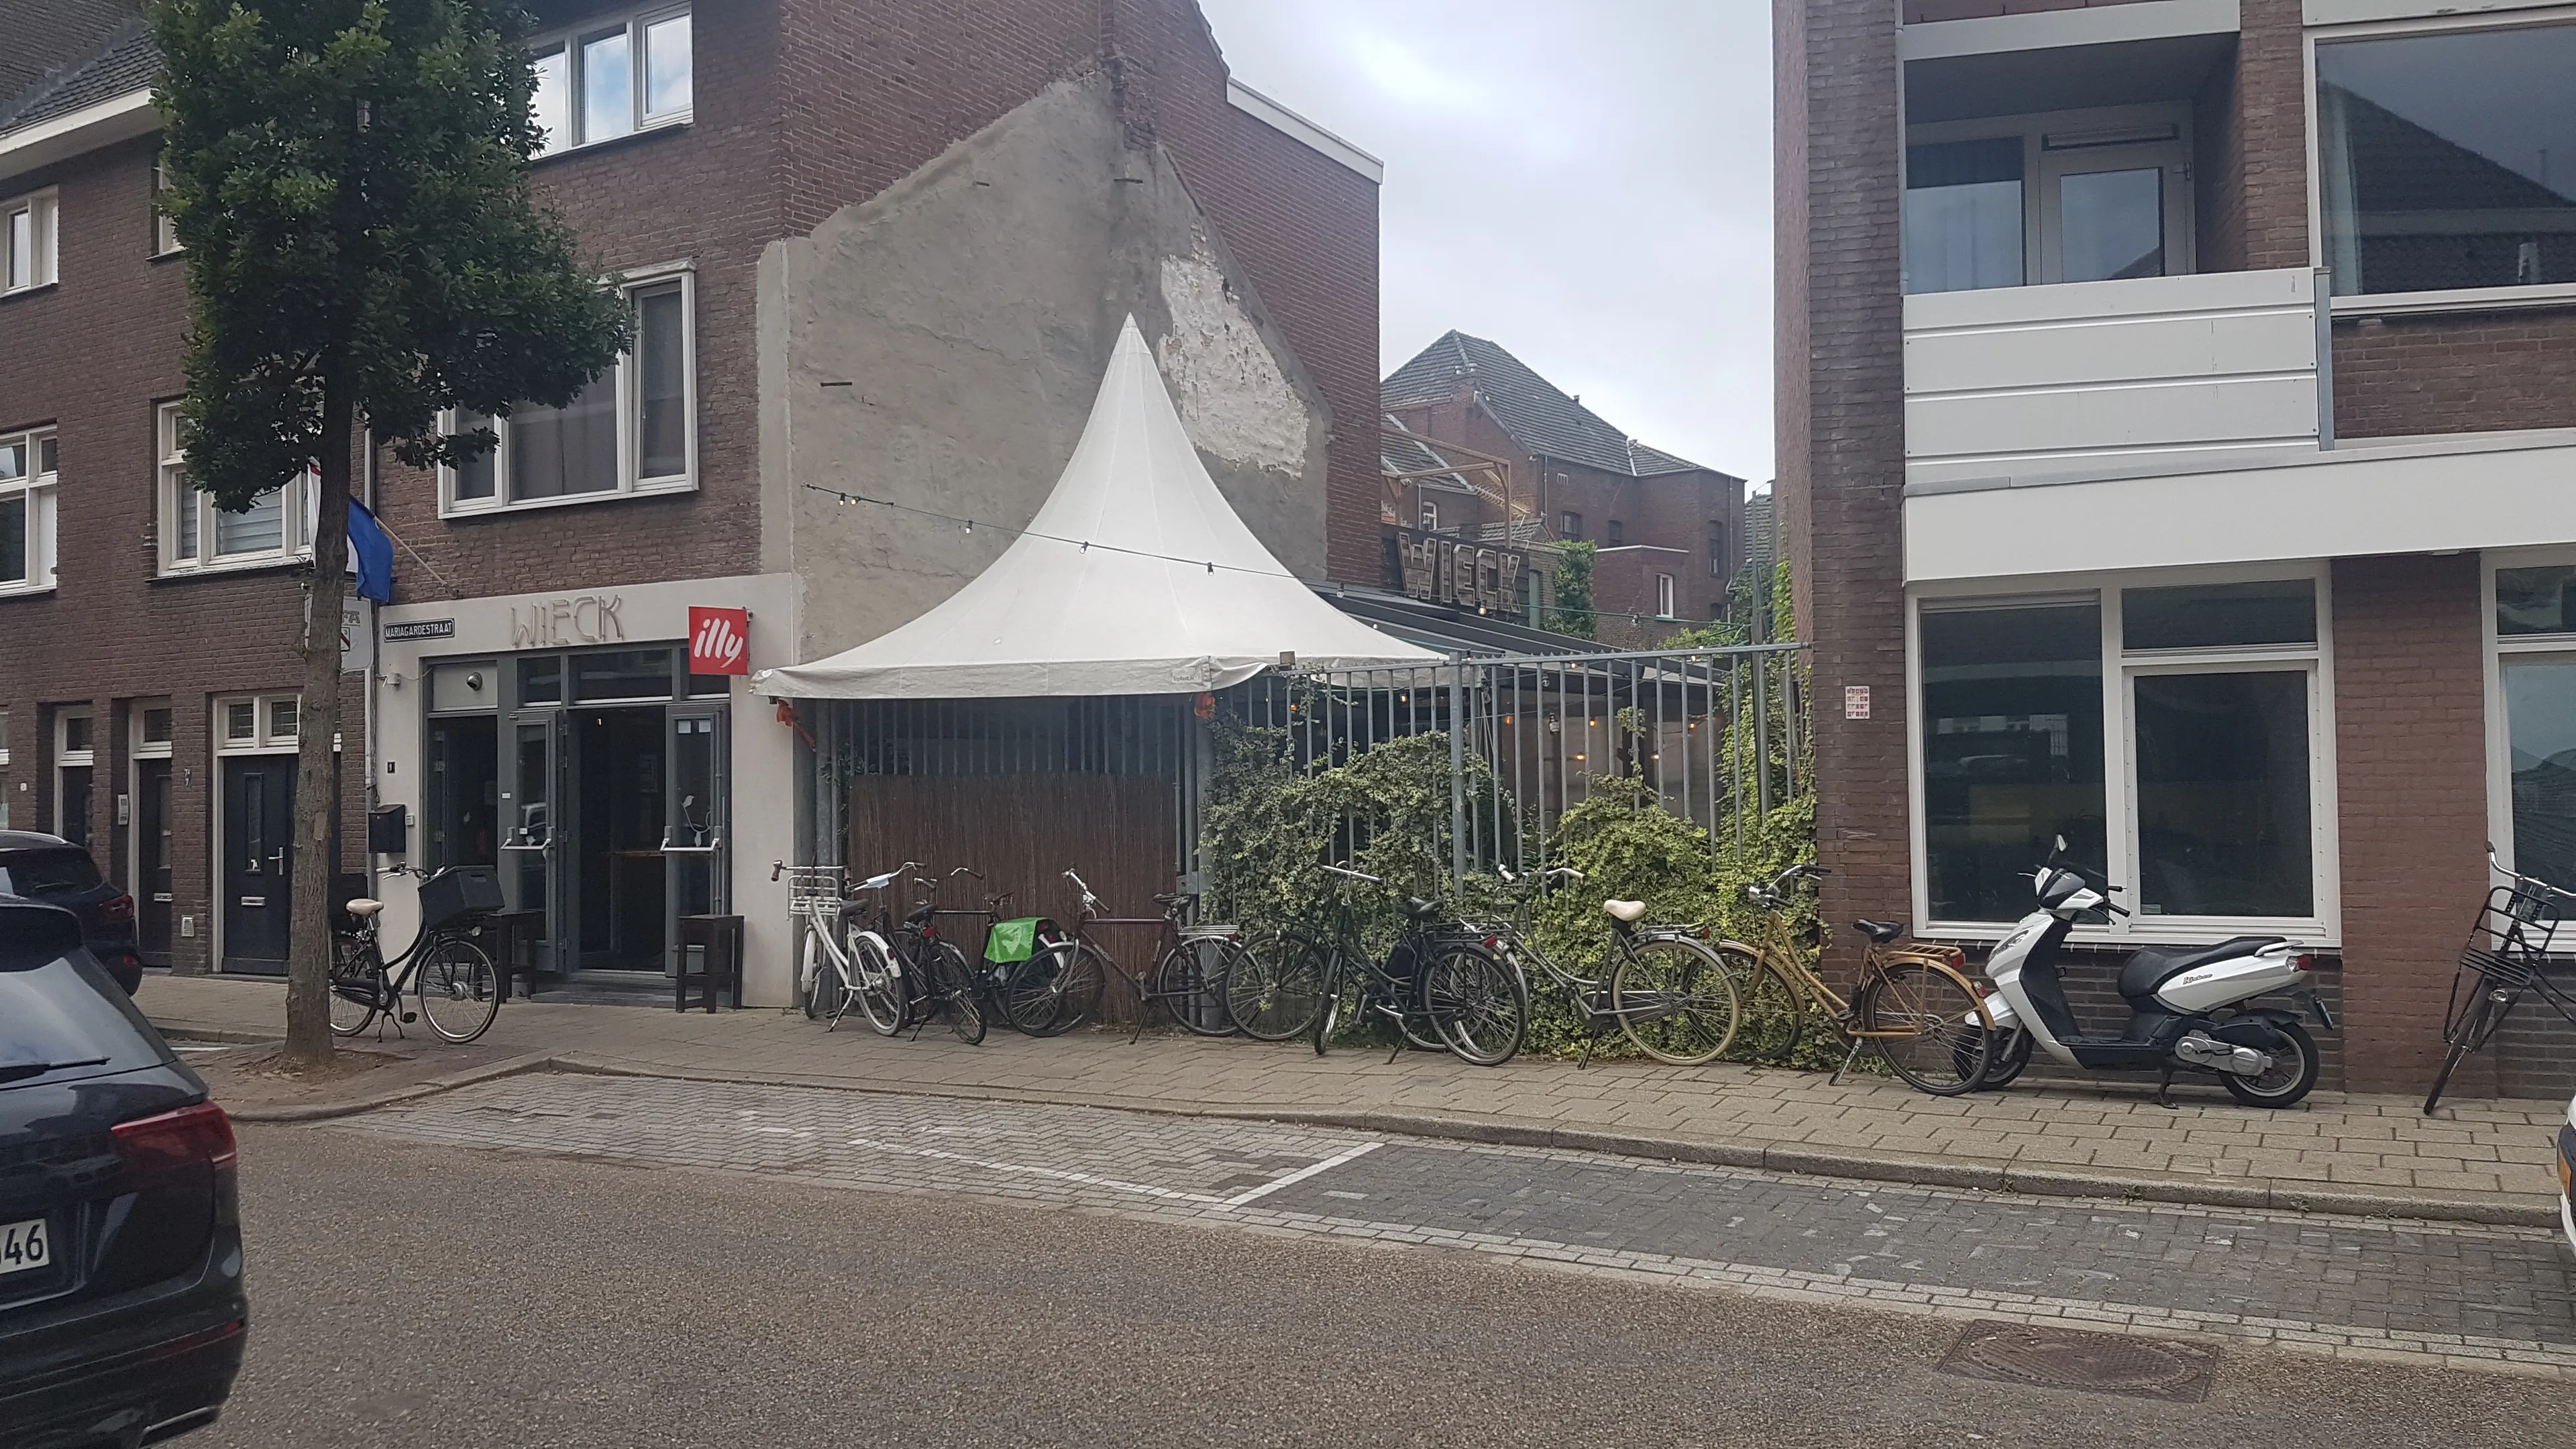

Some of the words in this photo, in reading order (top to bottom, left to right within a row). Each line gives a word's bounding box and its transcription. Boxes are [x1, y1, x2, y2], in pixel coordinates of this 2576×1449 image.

[1395, 532, 1521, 614] WIECK
[385, 623, 452, 637] MARIAGARDESTRAAT
[510, 594, 624, 648] WIECK
[694, 617, 744, 668] illy
[0, 1224, 44, 1266] 46
